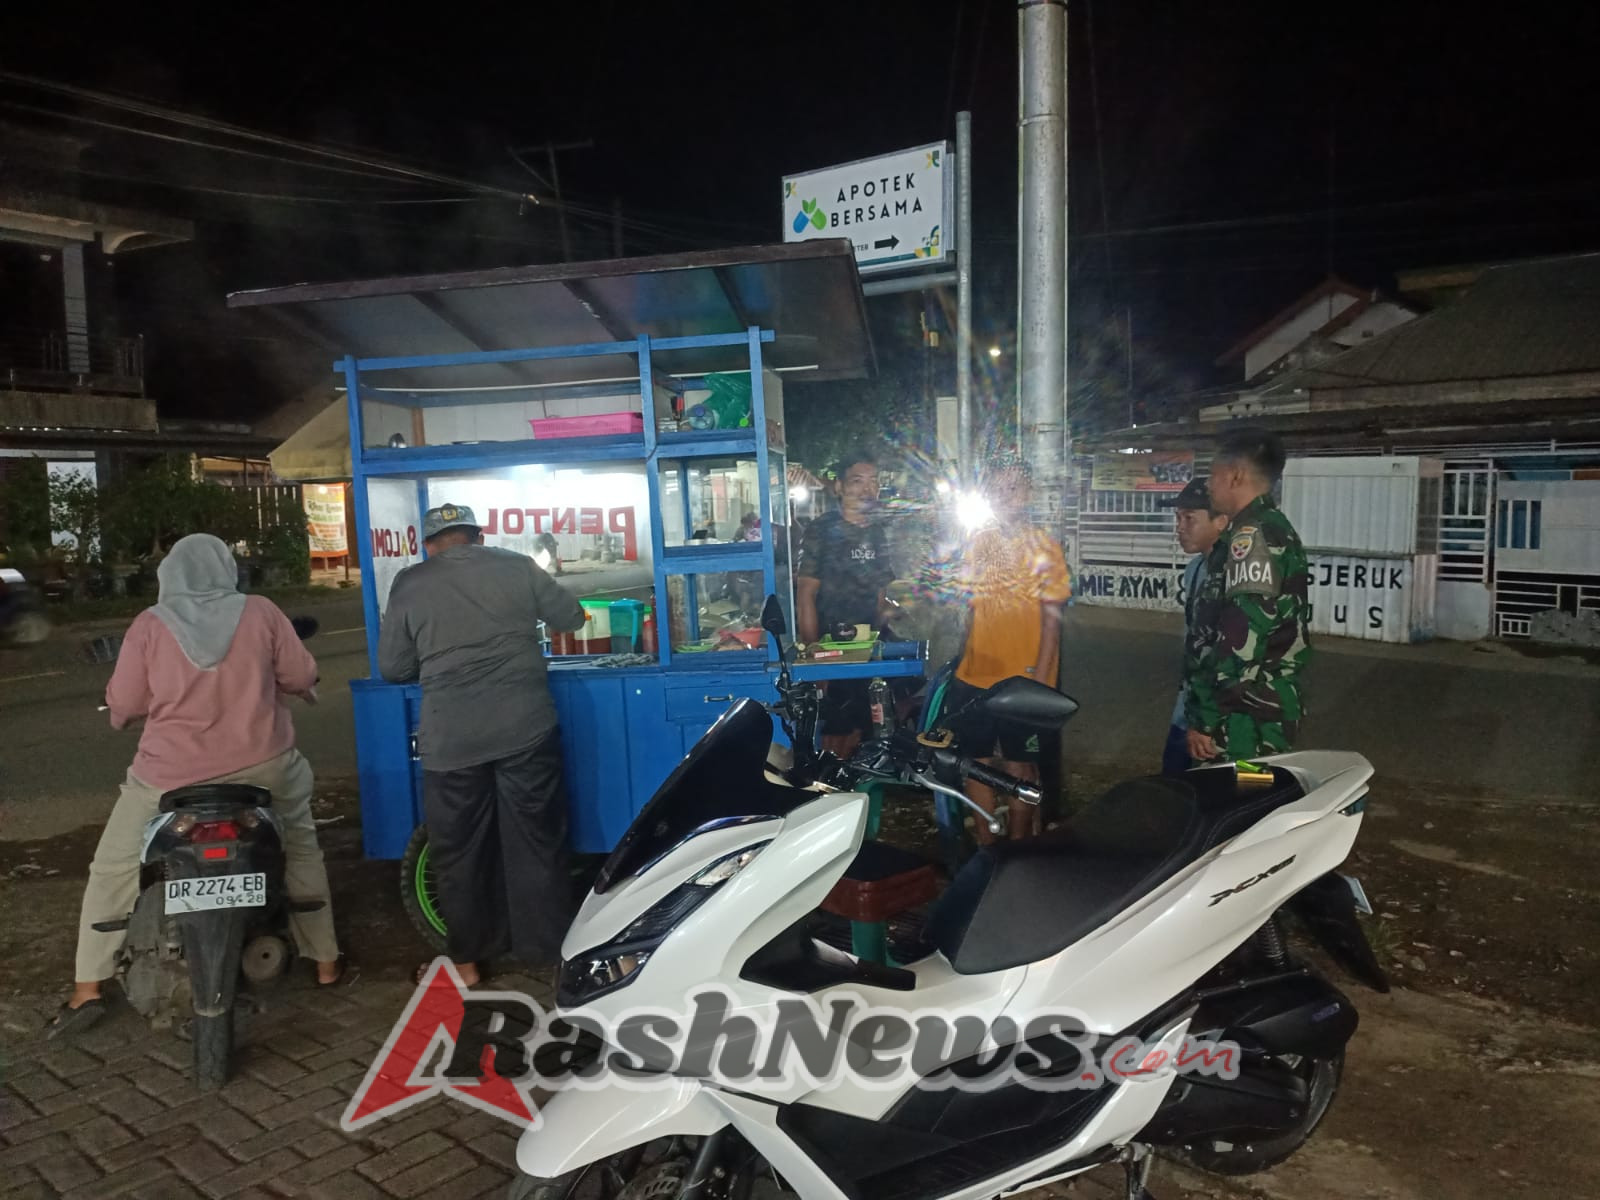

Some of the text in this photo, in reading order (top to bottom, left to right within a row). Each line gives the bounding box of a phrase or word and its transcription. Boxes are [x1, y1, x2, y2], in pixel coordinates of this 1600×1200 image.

[837, 172, 916, 203] APOTEK
[830, 197, 923, 228] BERSAMA
[1079, 574, 1115, 597] MIE
[1119, 575, 1168, 599] AYAM
[168, 875, 264, 899] DR 2274 EB
